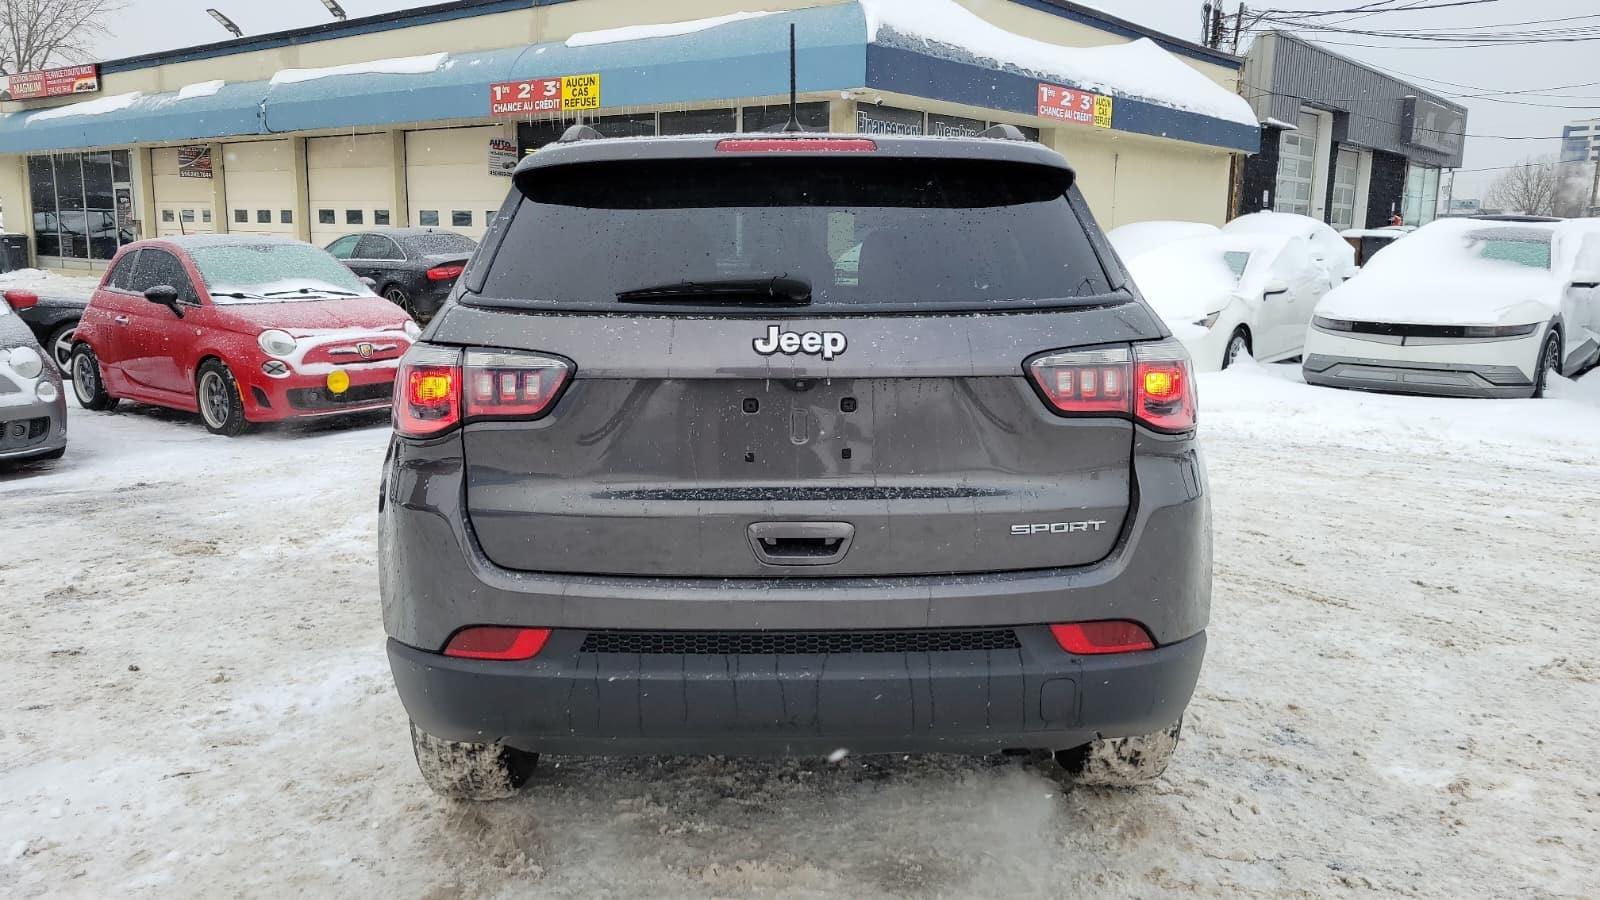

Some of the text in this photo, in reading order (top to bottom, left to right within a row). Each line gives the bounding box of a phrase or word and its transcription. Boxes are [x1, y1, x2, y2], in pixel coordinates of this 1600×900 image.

[13, 82, 42, 95] MAGNUM
[565, 76, 596, 88] AUCUN
[571, 87, 589, 97] CAS
[493, 97, 561, 113] CHANCE AU CRÉDIT
[564, 96, 597, 108] REFUSE
[1040, 104, 1064, 118] CHANCE
[1064, 108, 1073, 119] AU
[857, 110, 922, 136] Financement
[489, 139, 511, 147] AUTO
[752, 325, 848, 361] Jeep
[1010, 519, 1107, 535] SPORT
